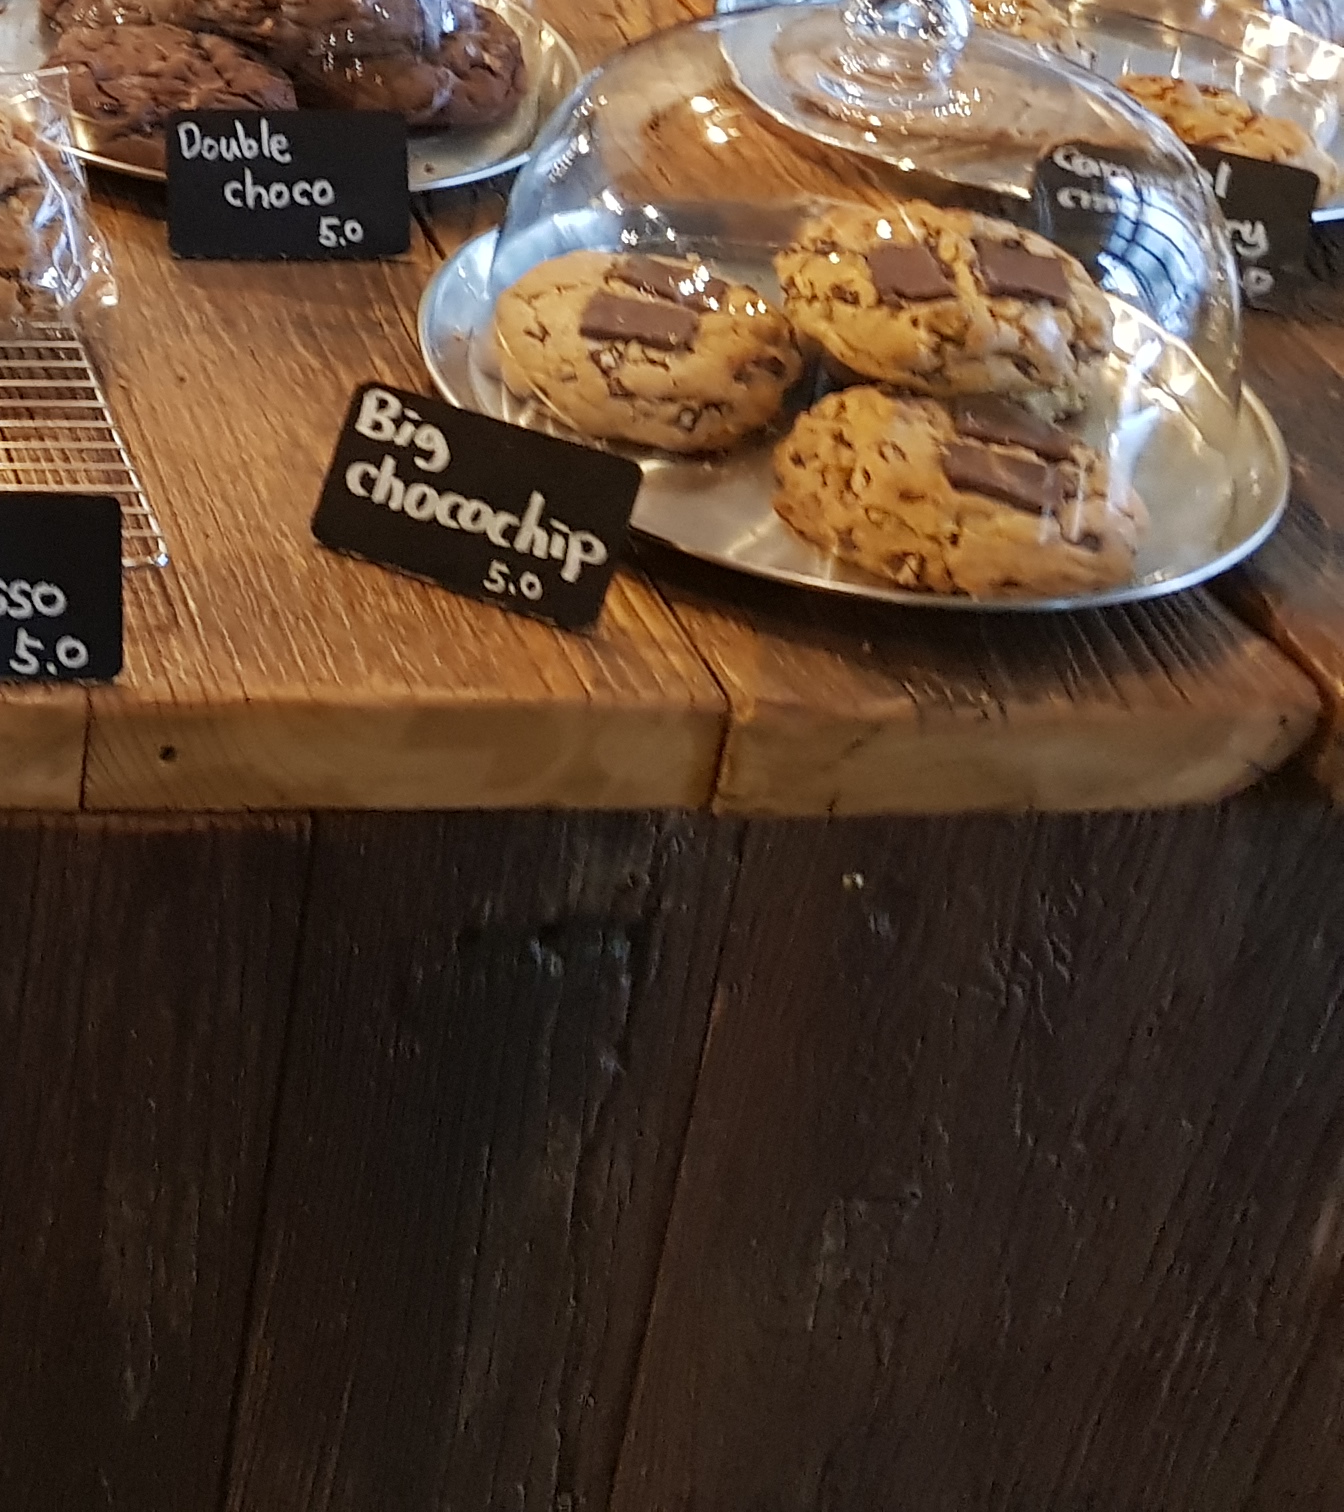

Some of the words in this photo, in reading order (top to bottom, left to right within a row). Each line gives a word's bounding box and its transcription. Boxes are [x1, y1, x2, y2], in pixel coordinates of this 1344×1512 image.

[177, 117, 292, 164] Double
[223, 166, 335, 210] choco
[318, 216, 364, 248] 5.0
[355, 388, 452, 473] Big
[345, 454, 608, 583] chocochip
[483, 558, 543, 601] 5.0
[9, 627, 89, 676] 5.0
